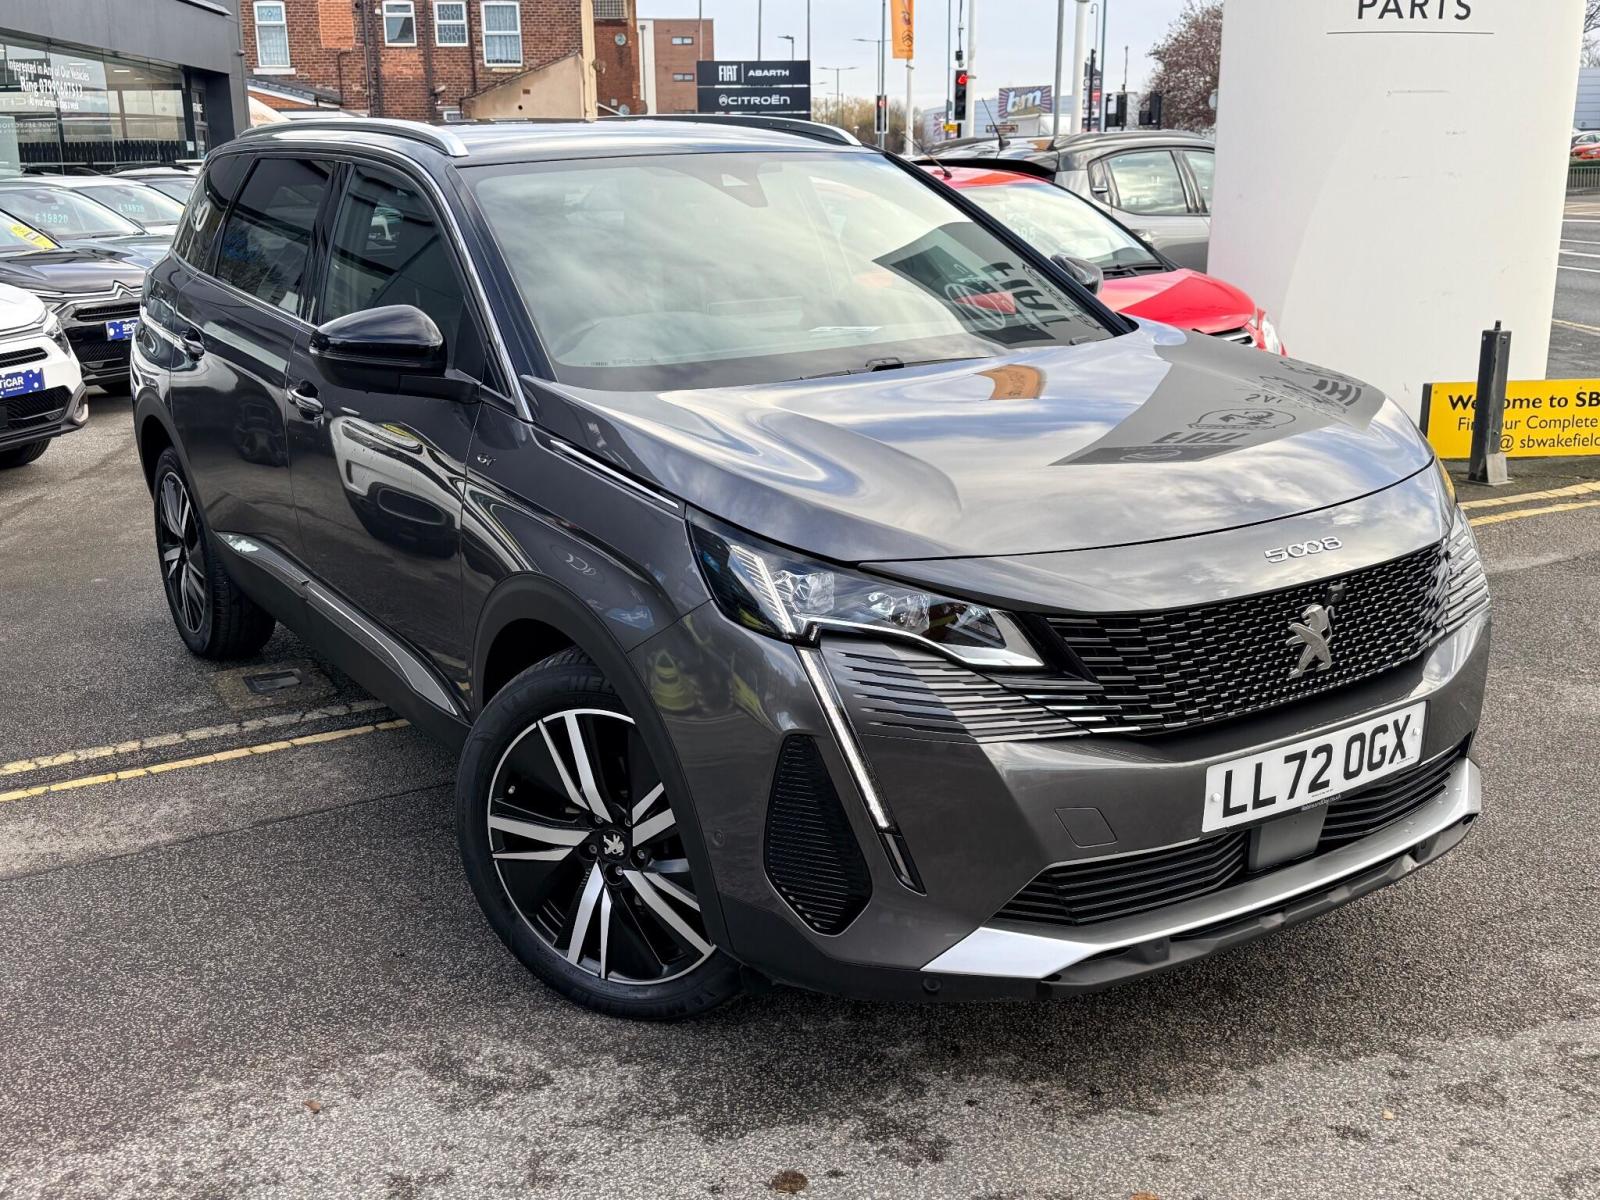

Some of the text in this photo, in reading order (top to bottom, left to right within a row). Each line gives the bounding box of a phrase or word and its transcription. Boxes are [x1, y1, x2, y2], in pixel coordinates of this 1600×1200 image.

[7, 58, 36, 74] Interested
[718, 65, 738, 82] FIAT
[747, 69, 789, 77] ABARTH
[20, 76, 38, 97] Ring
[1549, 394, 1568, 408] to
[1526, 414, 1598, 432] Complete
[1264, 536, 1342, 563] 5008
[1222, 714, 1411, 818] LL72 OGX
